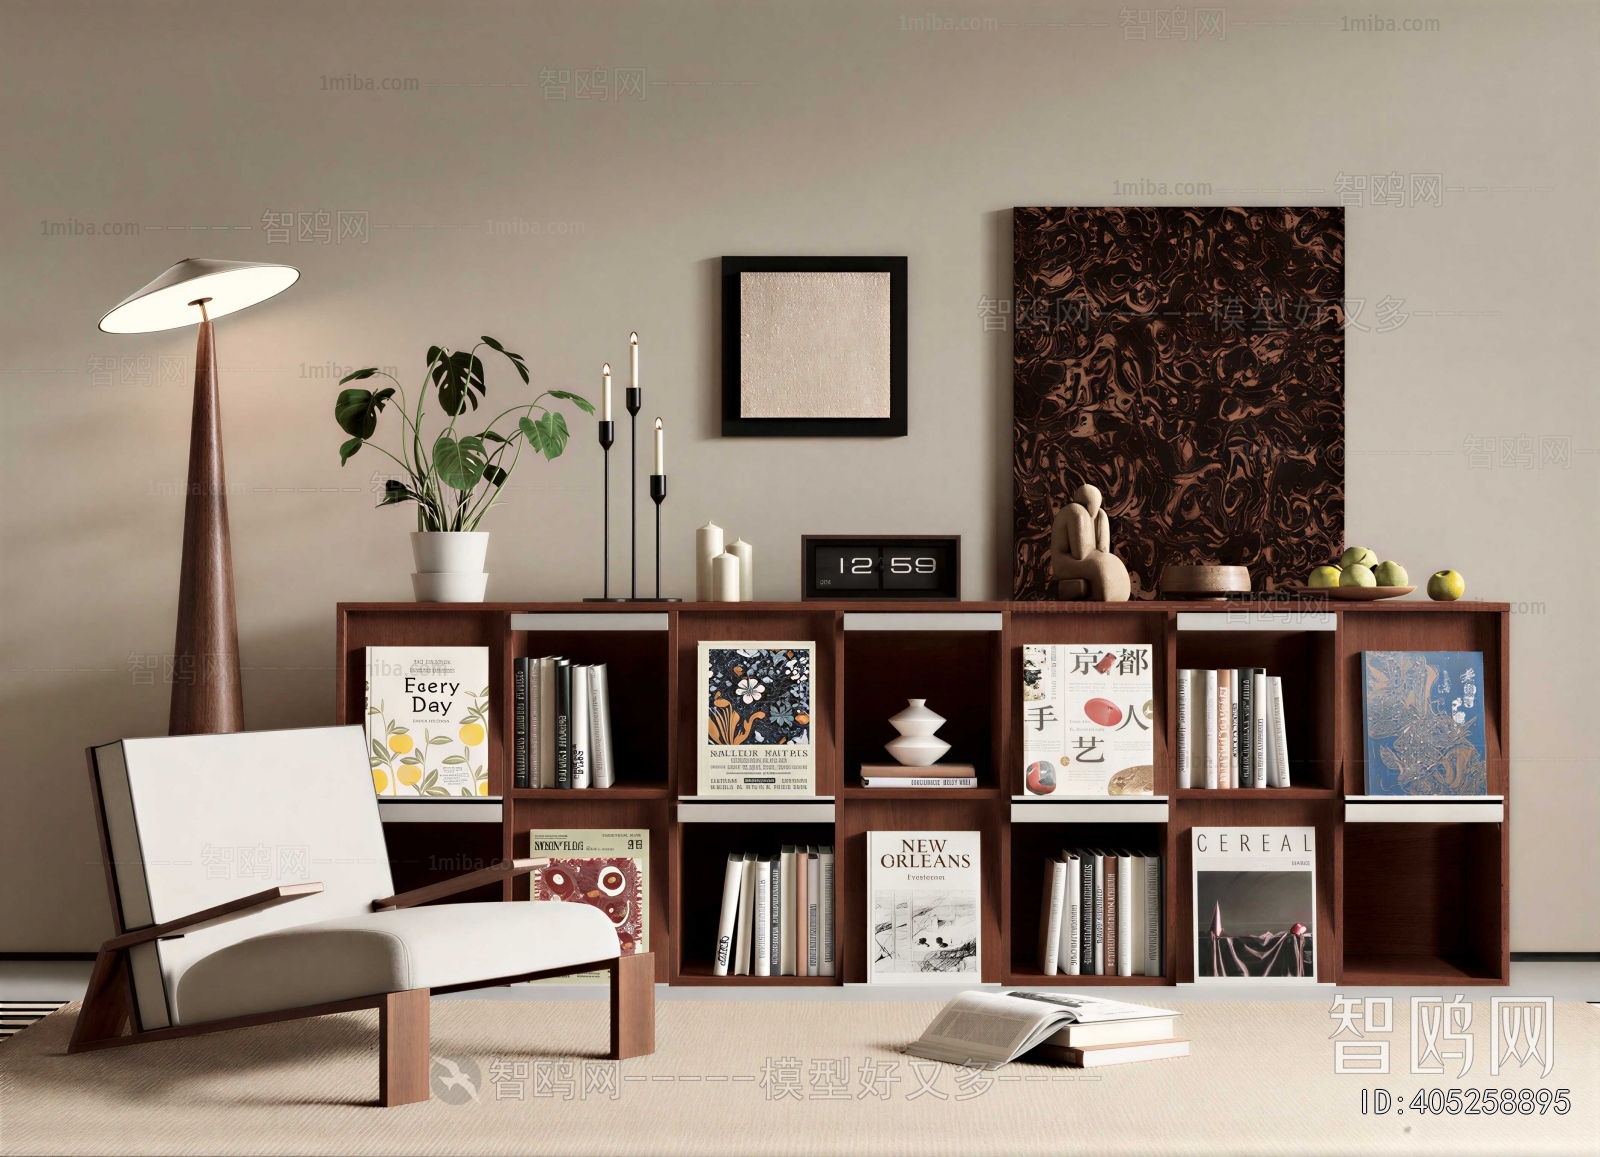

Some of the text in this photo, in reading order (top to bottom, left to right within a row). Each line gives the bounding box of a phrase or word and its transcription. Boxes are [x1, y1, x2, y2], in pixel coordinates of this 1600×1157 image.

[840, 557, 937, 574] 12 59
[412, 696, 452, 716] Day
[1024, 705, 1058, 731] 手
[1115, 705, 1150, 731] 人
[1071, 736, 1105, 763] 艺
[901, 839, 947, 853] NEW
[1197, 834, 1312, 852] CEREAL
[881, 854, 970, 868] ORLEANS
